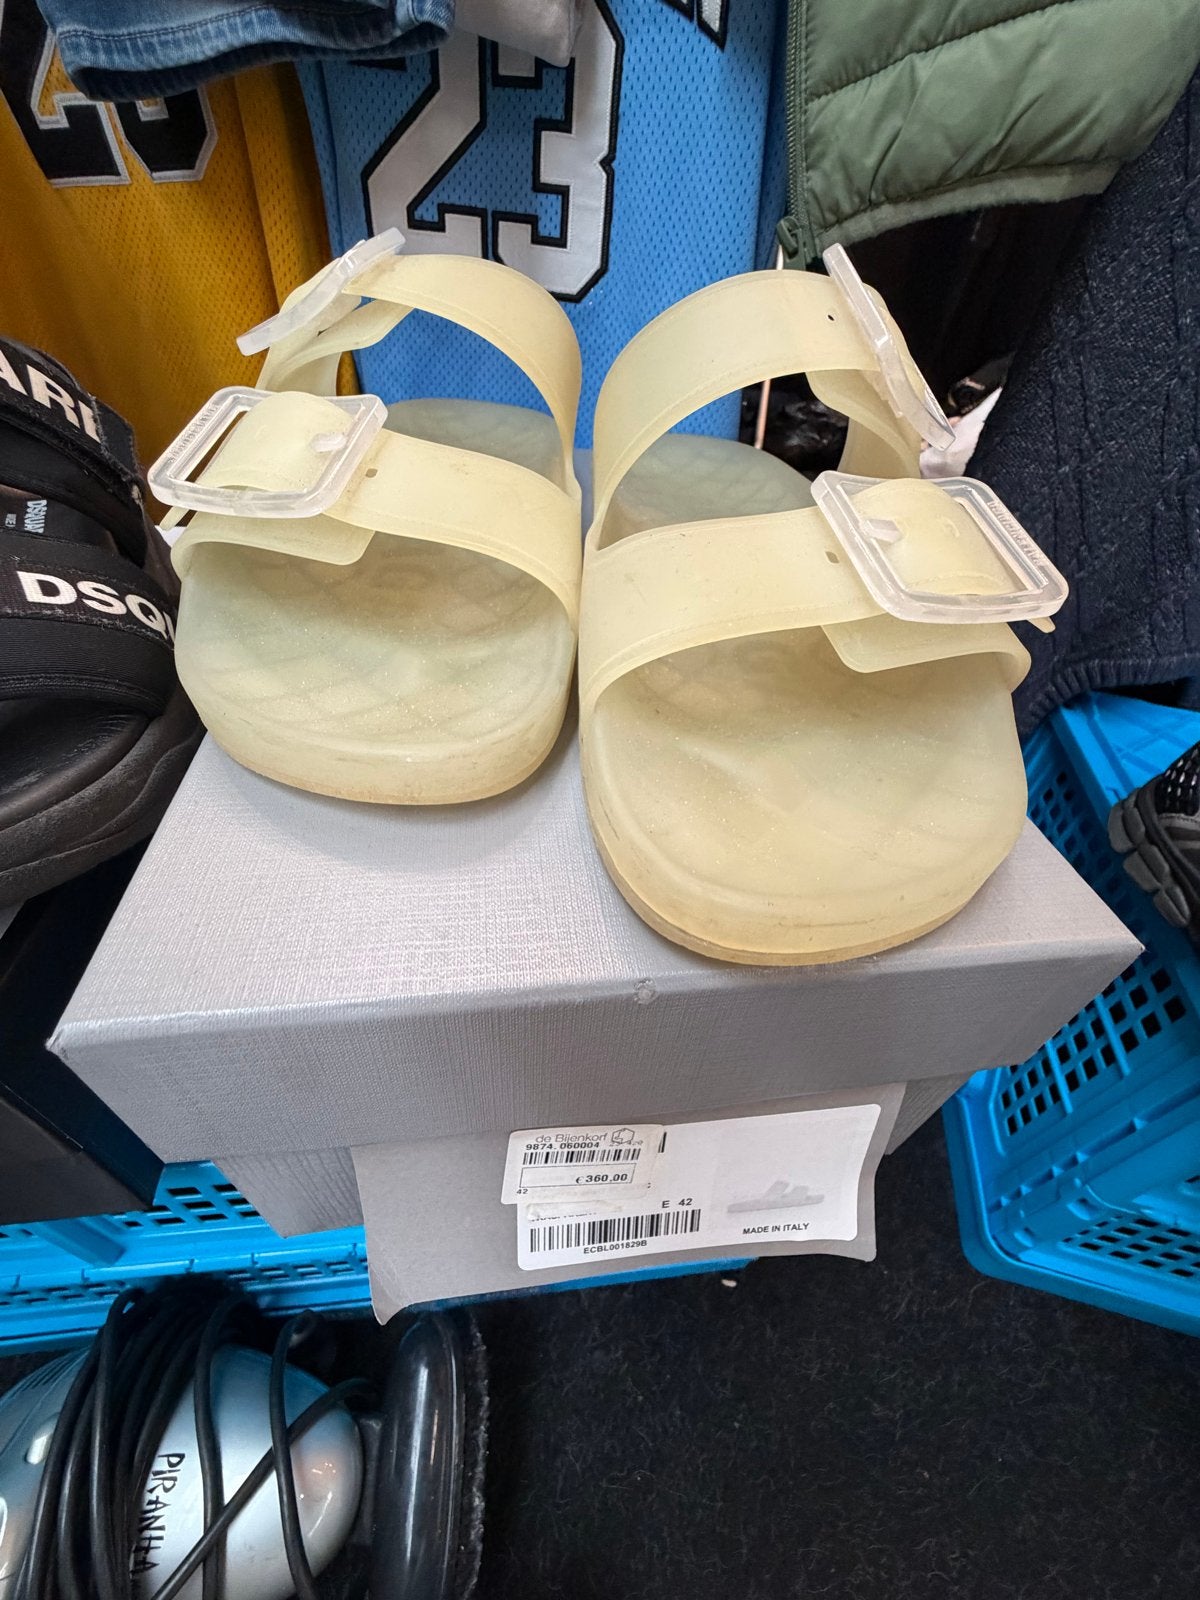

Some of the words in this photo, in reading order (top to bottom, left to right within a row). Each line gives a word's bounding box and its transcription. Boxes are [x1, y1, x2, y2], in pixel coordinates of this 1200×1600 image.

[536, 1133, 552, 1143] de
[678, 1198, 693, 1207] 42
[743, 1226, 770, 1235] MADE
[771, 1225, 781, 1234] IN
[783, 1222, 810, 1232] ITALY
[583, 1239, 648, 1255] ECBL001829B
[130, 1453, 187, 1575] PIRANHA
